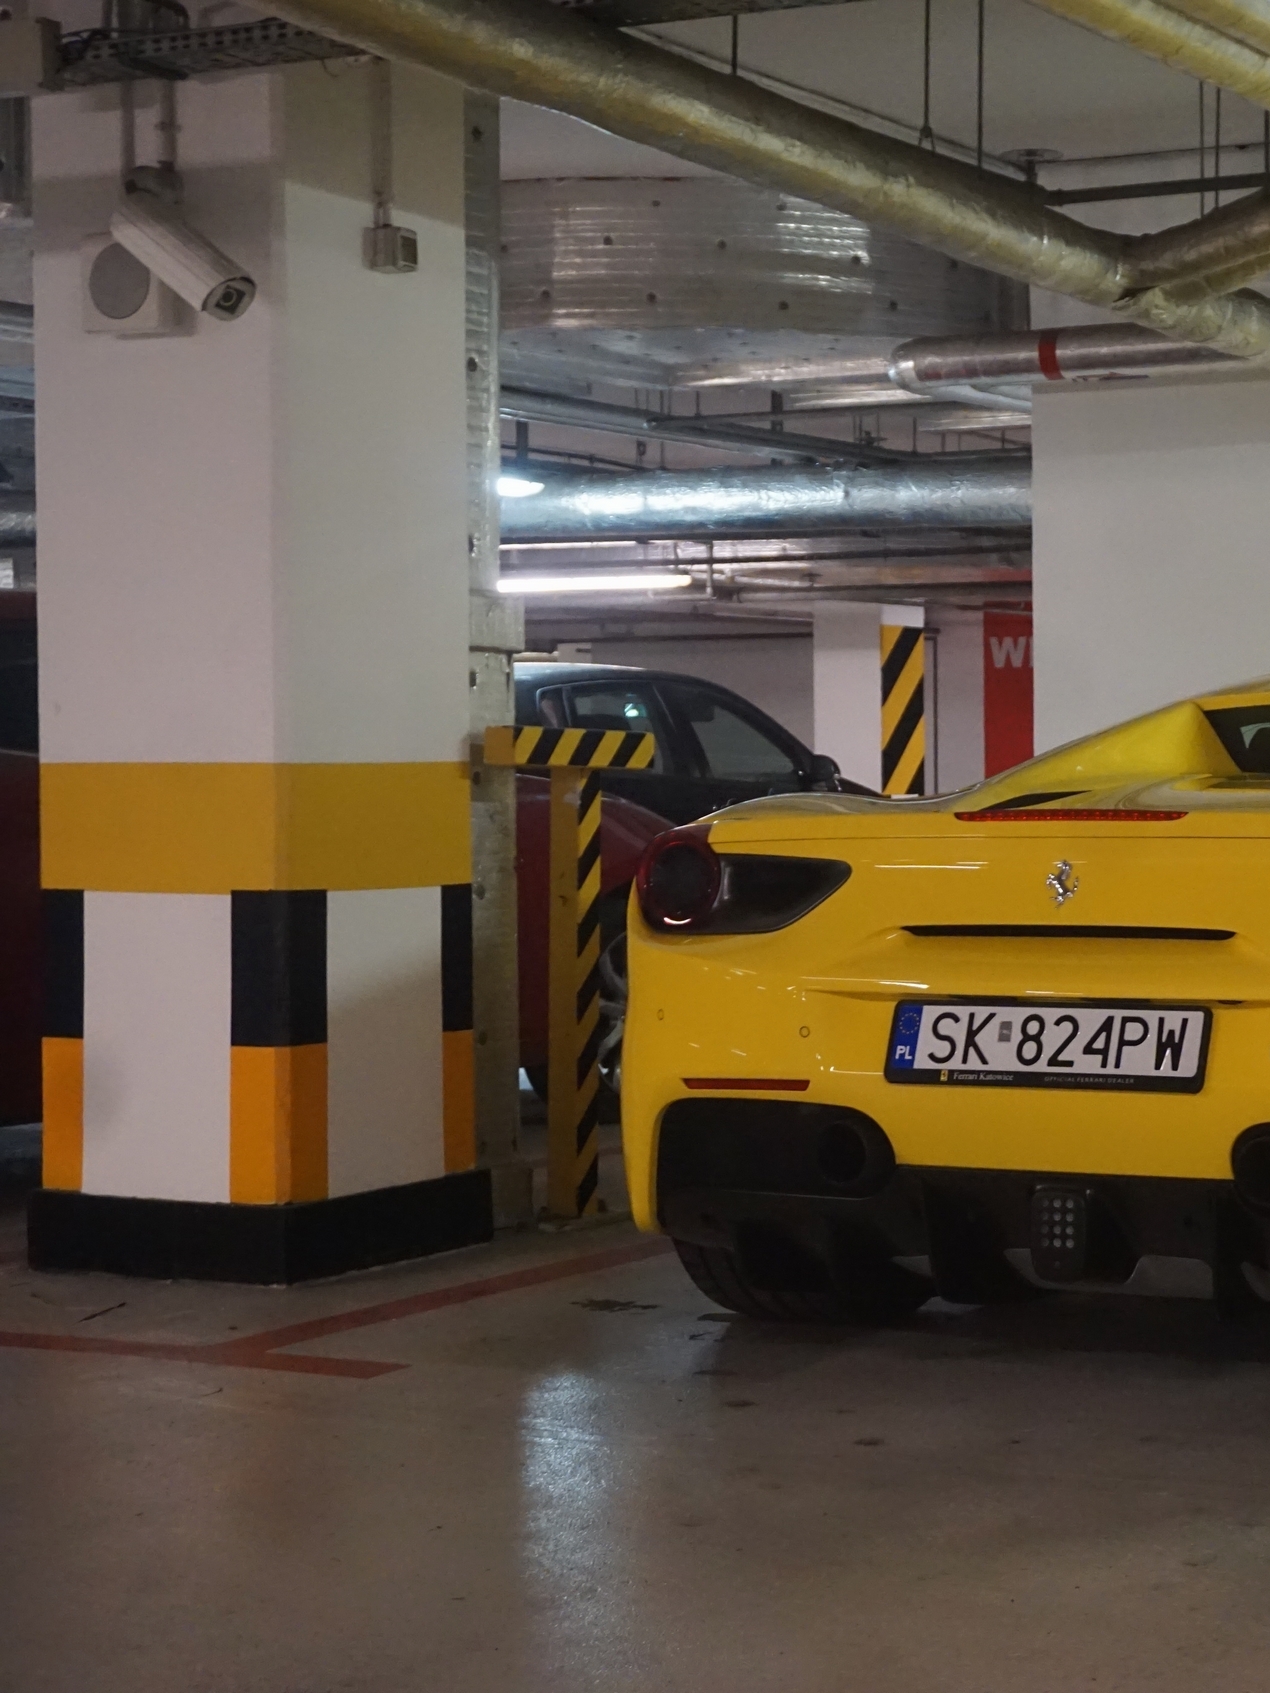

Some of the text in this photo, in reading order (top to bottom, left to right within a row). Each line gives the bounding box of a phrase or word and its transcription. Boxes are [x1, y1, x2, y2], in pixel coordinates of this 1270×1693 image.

[927, 1012, 1189, 1072] SK 824PW
[895, 1045, 913, 1060] PL
[953, 1071, 1014, 1081] Ferrari Katowice
